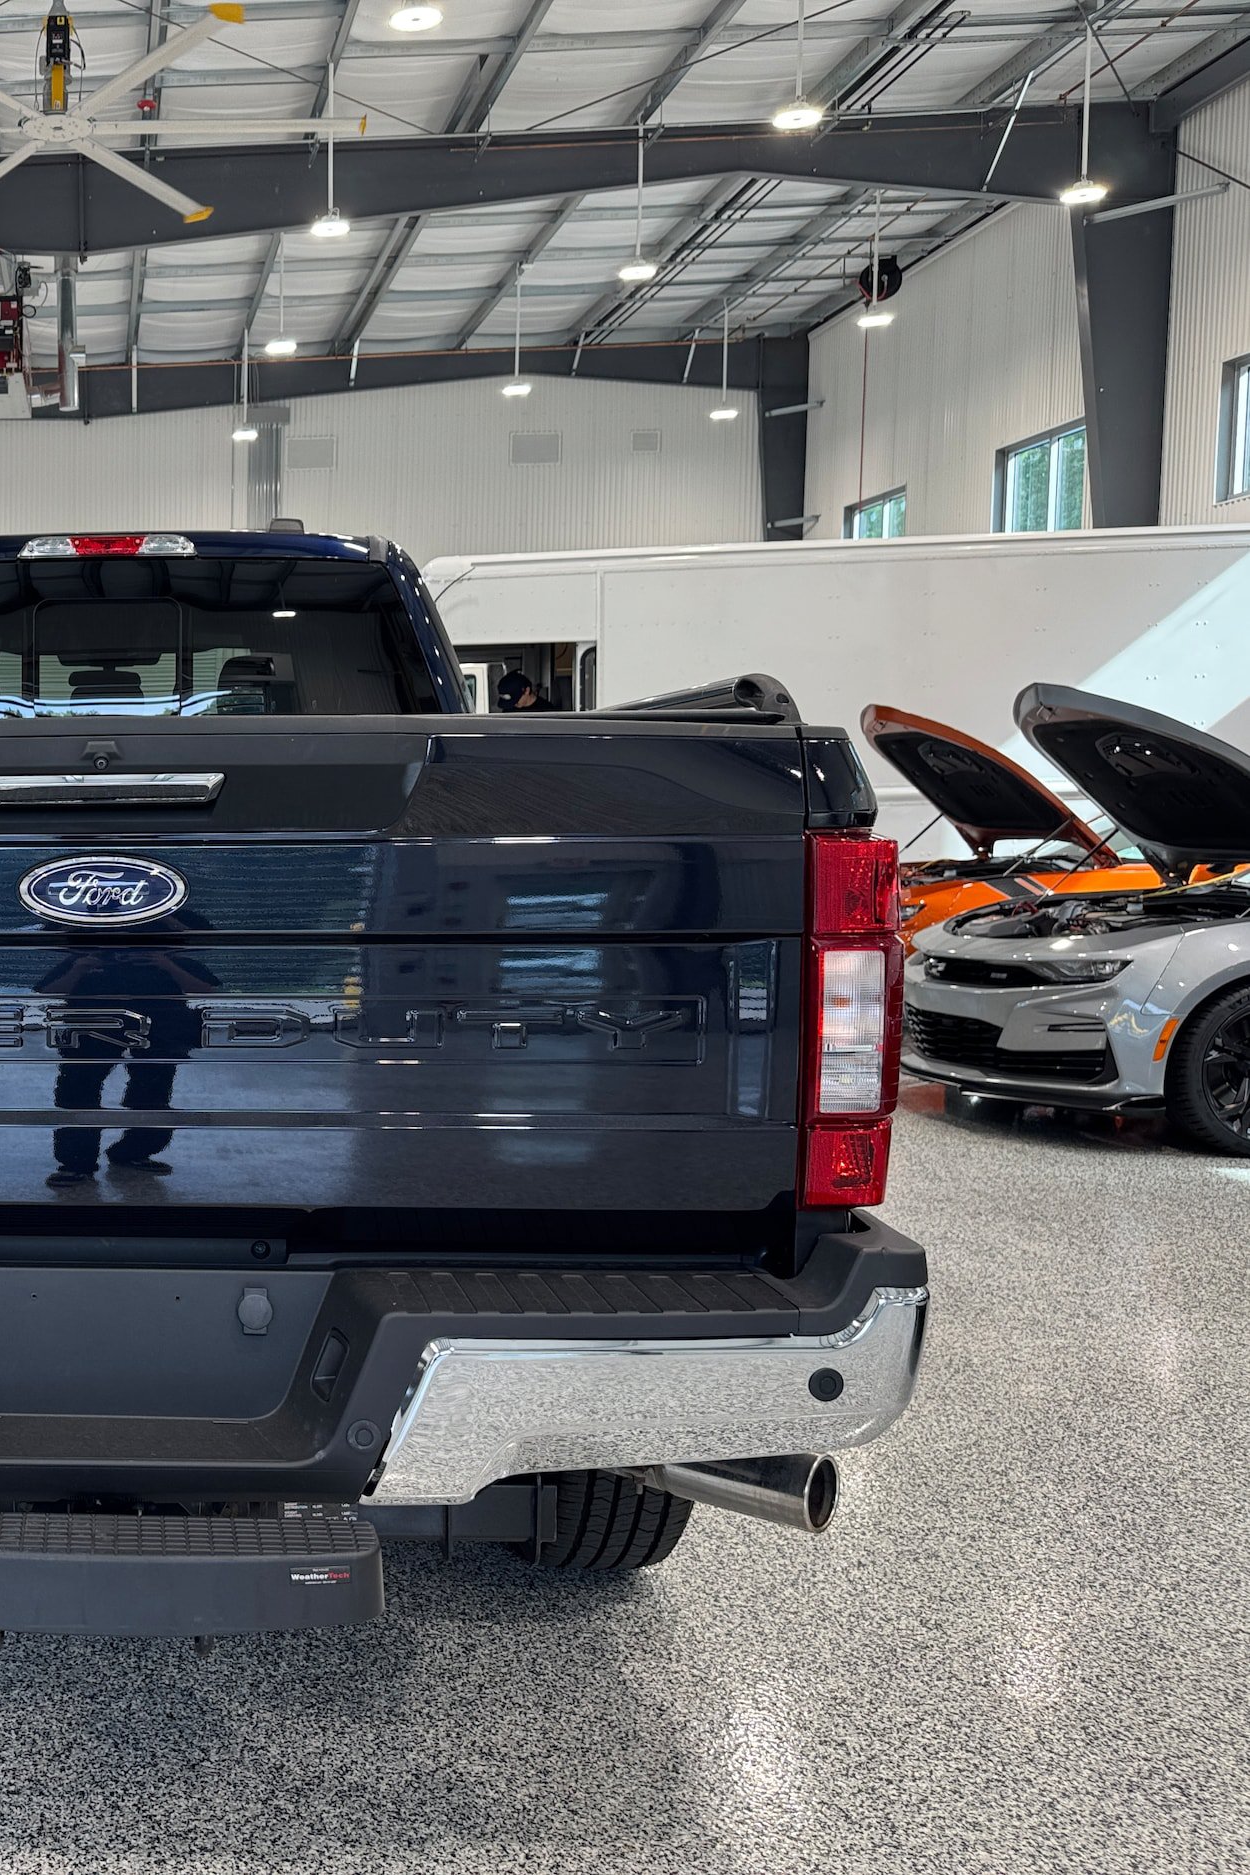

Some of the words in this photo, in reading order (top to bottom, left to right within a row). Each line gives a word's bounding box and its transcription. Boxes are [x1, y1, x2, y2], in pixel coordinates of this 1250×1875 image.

[58, 870, 145, 906] Ford
[201, 1007, 684, 1050] DUTY
[291, 1572, 350, 1580] WeatherTech
